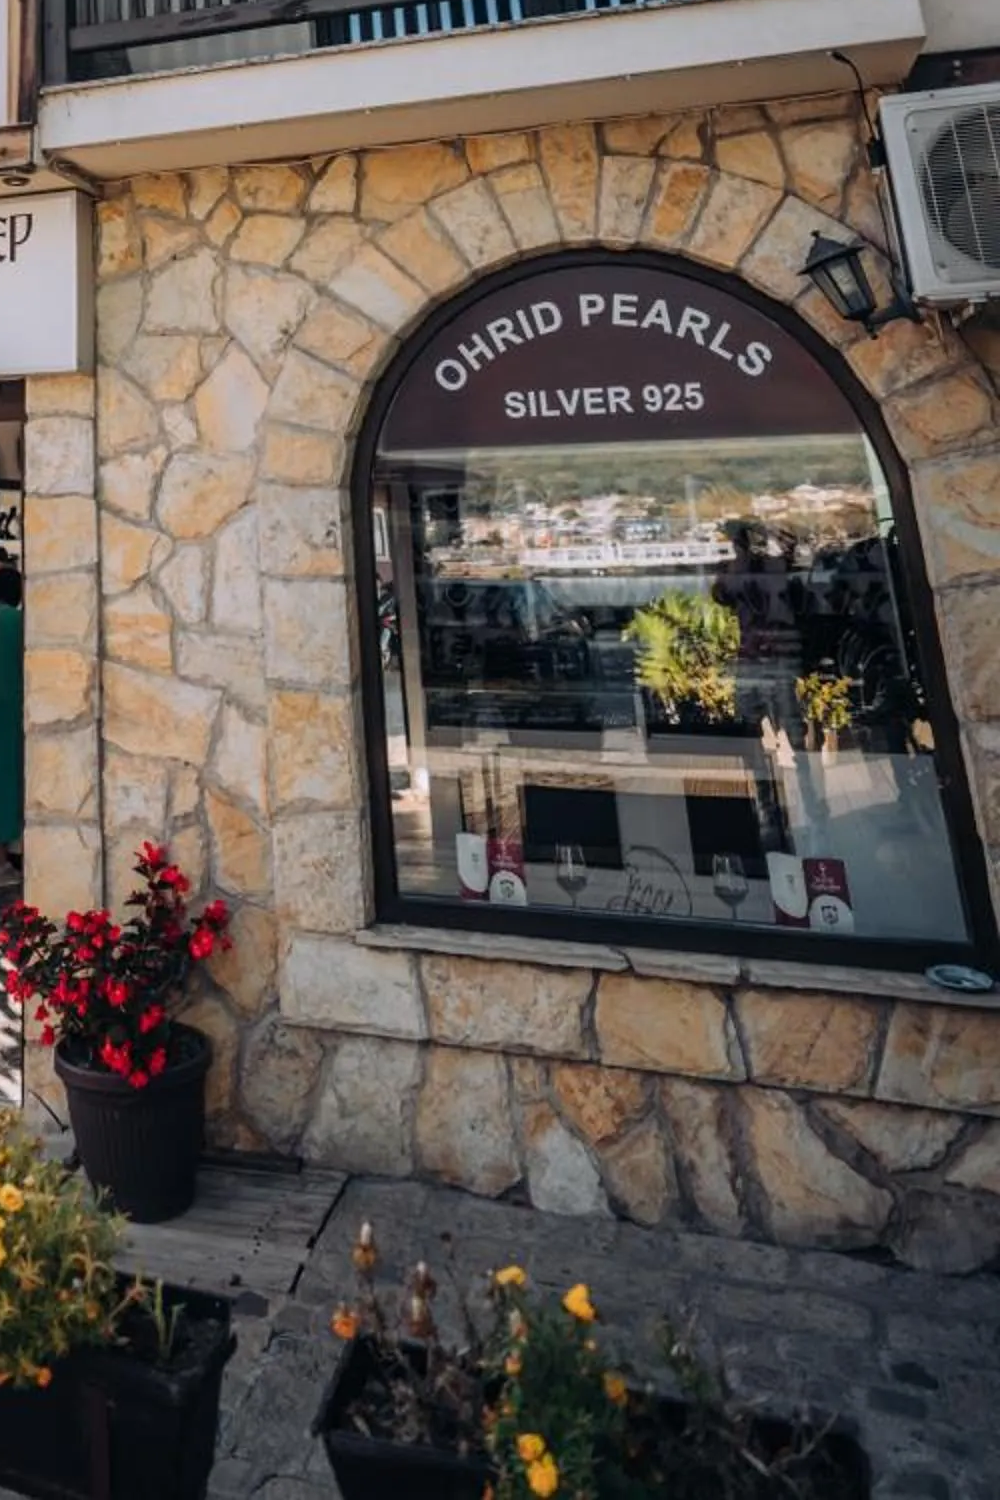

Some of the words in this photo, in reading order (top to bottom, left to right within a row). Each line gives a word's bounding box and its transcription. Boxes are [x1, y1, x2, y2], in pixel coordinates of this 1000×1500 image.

[434, 301, 563, 392] OHRID
[579, 294, 772, 378] PEARLS
[505, 386, 634, 419] SILVER
[643, 382, 704, 412] 925
